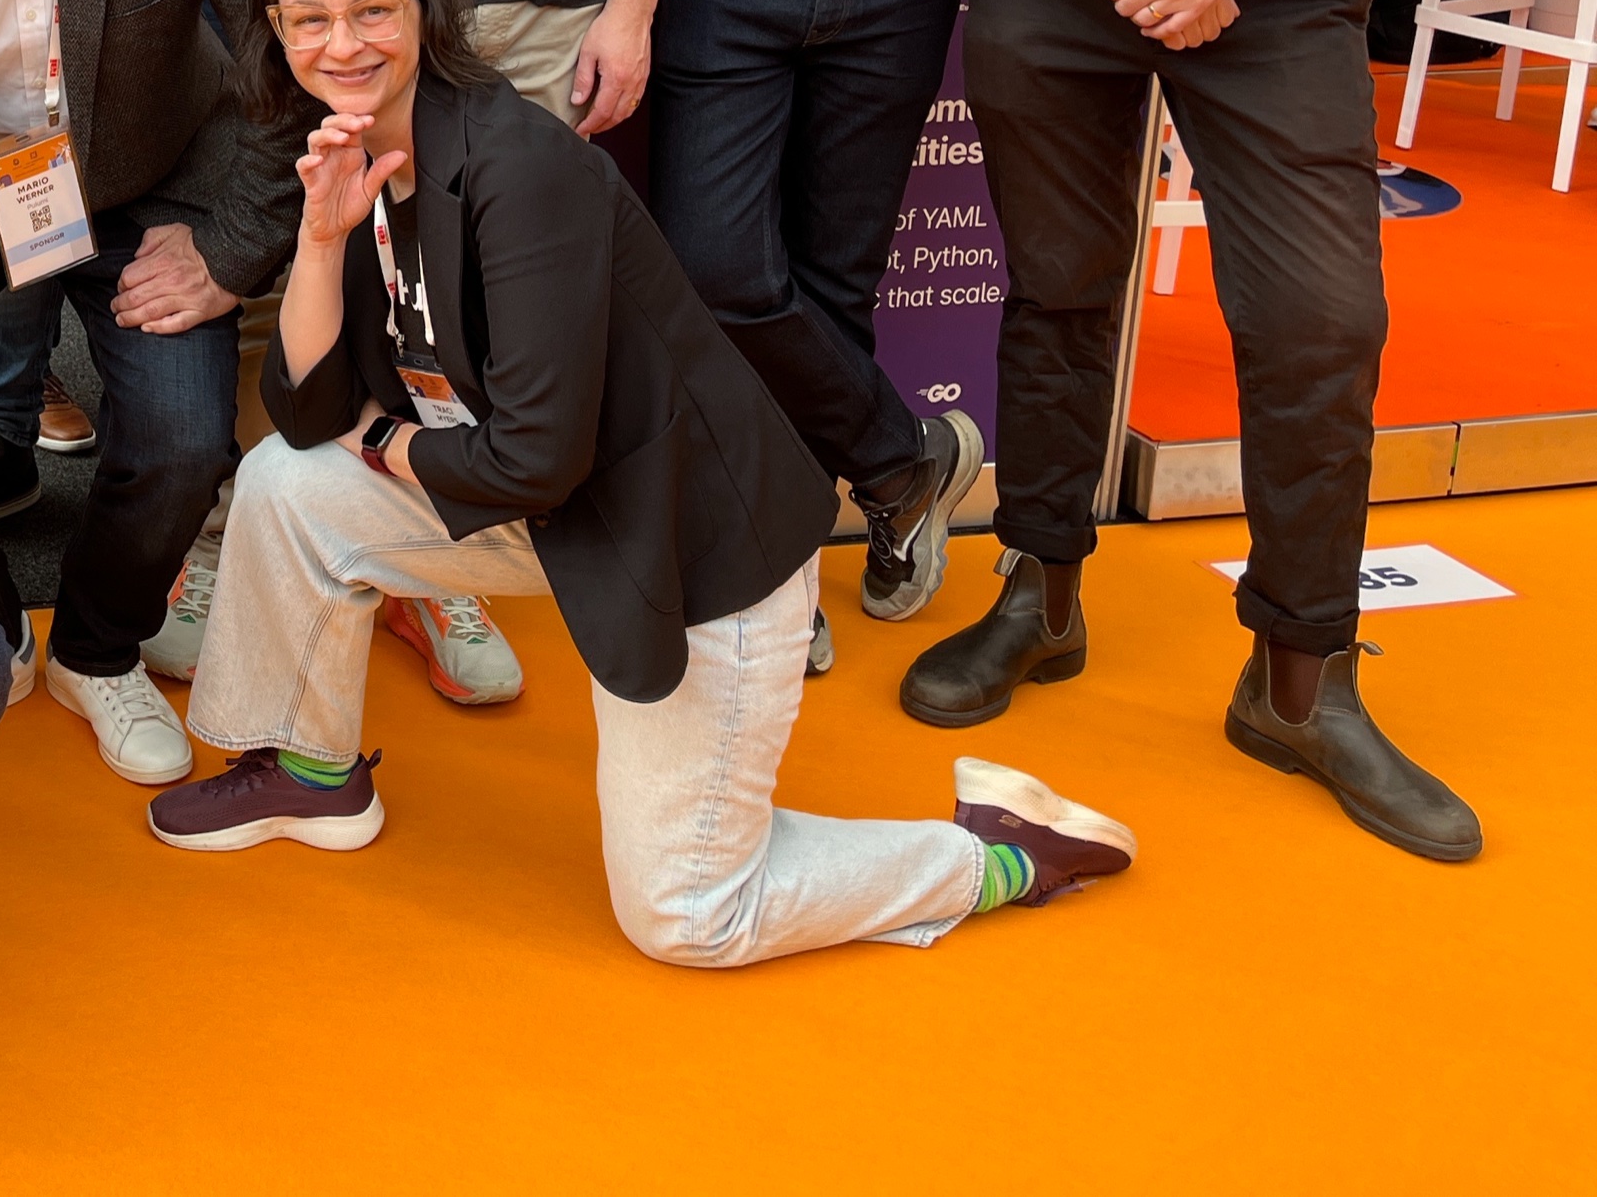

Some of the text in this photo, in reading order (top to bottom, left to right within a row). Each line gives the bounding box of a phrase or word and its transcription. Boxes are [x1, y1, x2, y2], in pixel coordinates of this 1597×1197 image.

[912, 135, 984, 167] ities
[16, 184, 55, 204] WERNER
[17, 177, 49, 194] MARIO
[895, 206, 987, 232] of YAML
[30, 232, 65, 251] SPONSOR
[913, 245, 998, 274] Python,
[888, 282, 1005, 309] that scale.
[927, 383, 961, 403] GO
